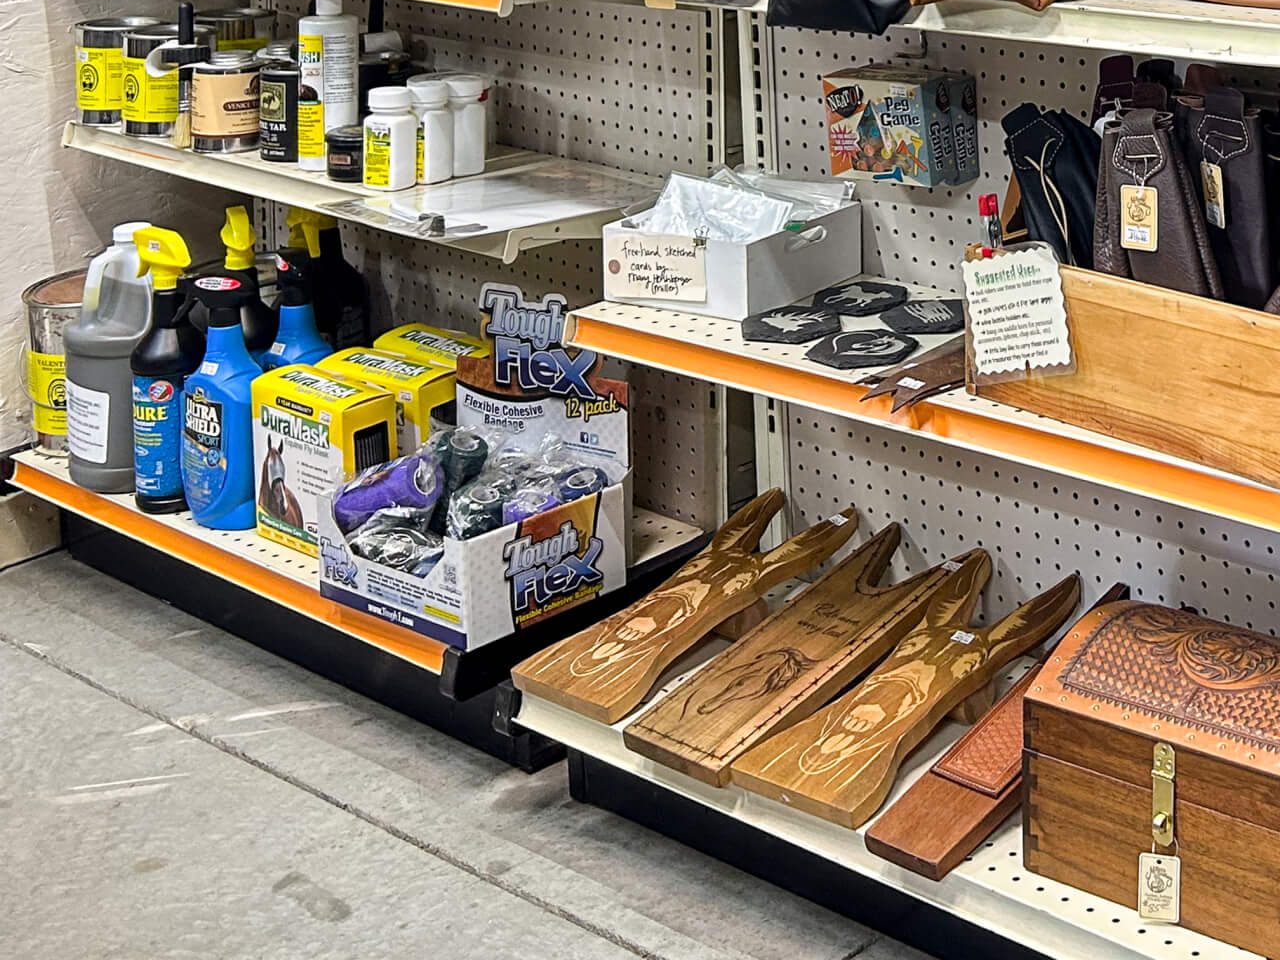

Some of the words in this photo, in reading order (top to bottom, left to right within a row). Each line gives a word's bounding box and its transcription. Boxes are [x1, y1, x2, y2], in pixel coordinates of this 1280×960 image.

[299, 52, 319, 63] USH
[884, 96, 910, 113] Peg
[269, 122, 287, 132] TAR
[880, 112, 921, 127] Game
[929, 121, 944, 170] Game
[941, 123, 953, 158] Peg
[664, 244, 697, 259] sketched
[630, 262, 652, 271] cards
[485, 290, 564, 349] Tough
[37, 359, 66, 368] VALENT
[282, 370, 359, 399] DuraMask
[133, 405, 168, 421] URE
[186, 397, 218, 422] ULTRA
[464, 394, 501, 415] Flexible
[502, 404, 544, 417] Cohesive
[565, 398, 581, 418] 12
[584, 393, 620, 422] pack
[185, 413, 221, 437] SHIELD
[261, 406, 330, 449] DuraMask
[484, 414, 525, 432] Bandage
[304, 444, 313, 456] Fly
[313, 447, 329, 458] Mask
[503, 520, 579, 578] Tough
[543, 595, 573, 611] Cohesive
